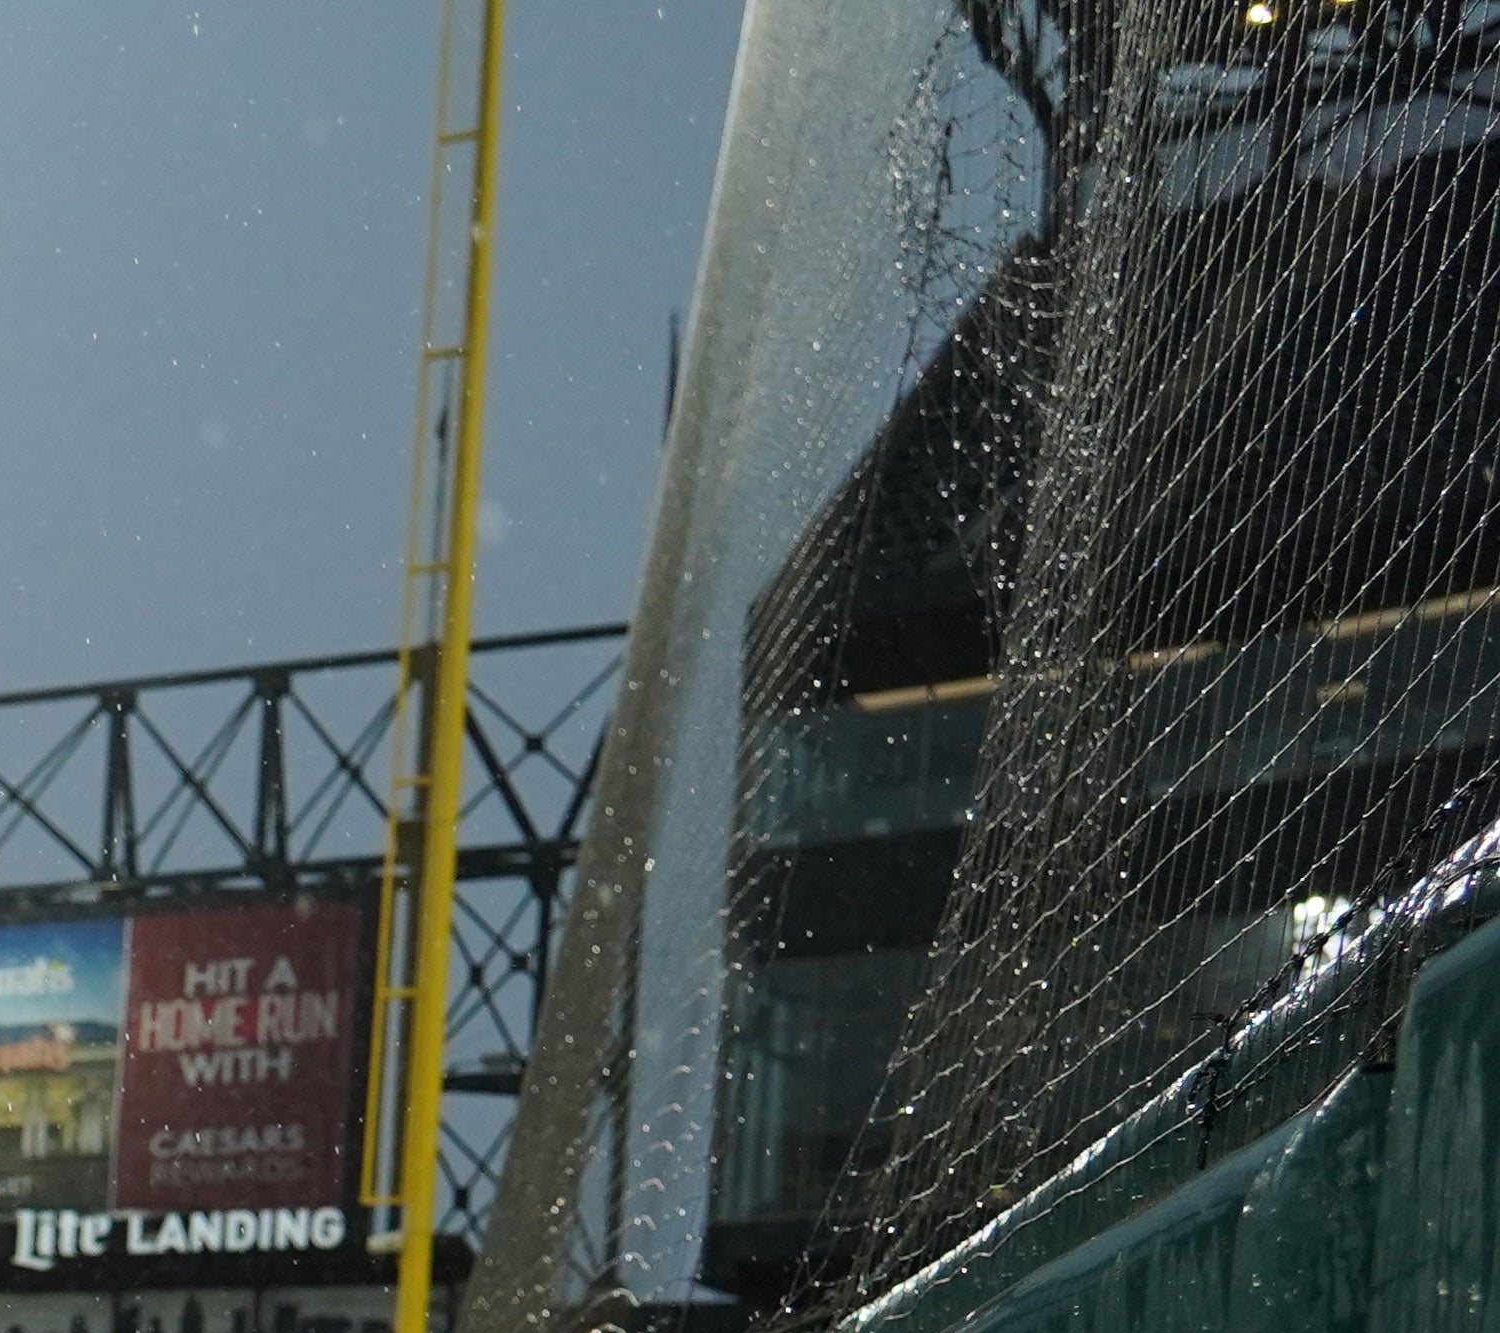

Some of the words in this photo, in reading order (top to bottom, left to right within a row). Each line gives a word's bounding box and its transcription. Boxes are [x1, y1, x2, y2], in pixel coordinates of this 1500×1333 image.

[182, 957, 255, 998] HIT
[264, 955, 298, 991] A
[139, 997, 249, 1052] HOME
[257, 990, 339, 1044] RUN
[179, 1049, 293, 1087] WITH
[150, 1122, 305, 1159] CAESARS
[11, 1207, 112, 1271] Lite
[126, 1205, 346, 1256] LANDING
